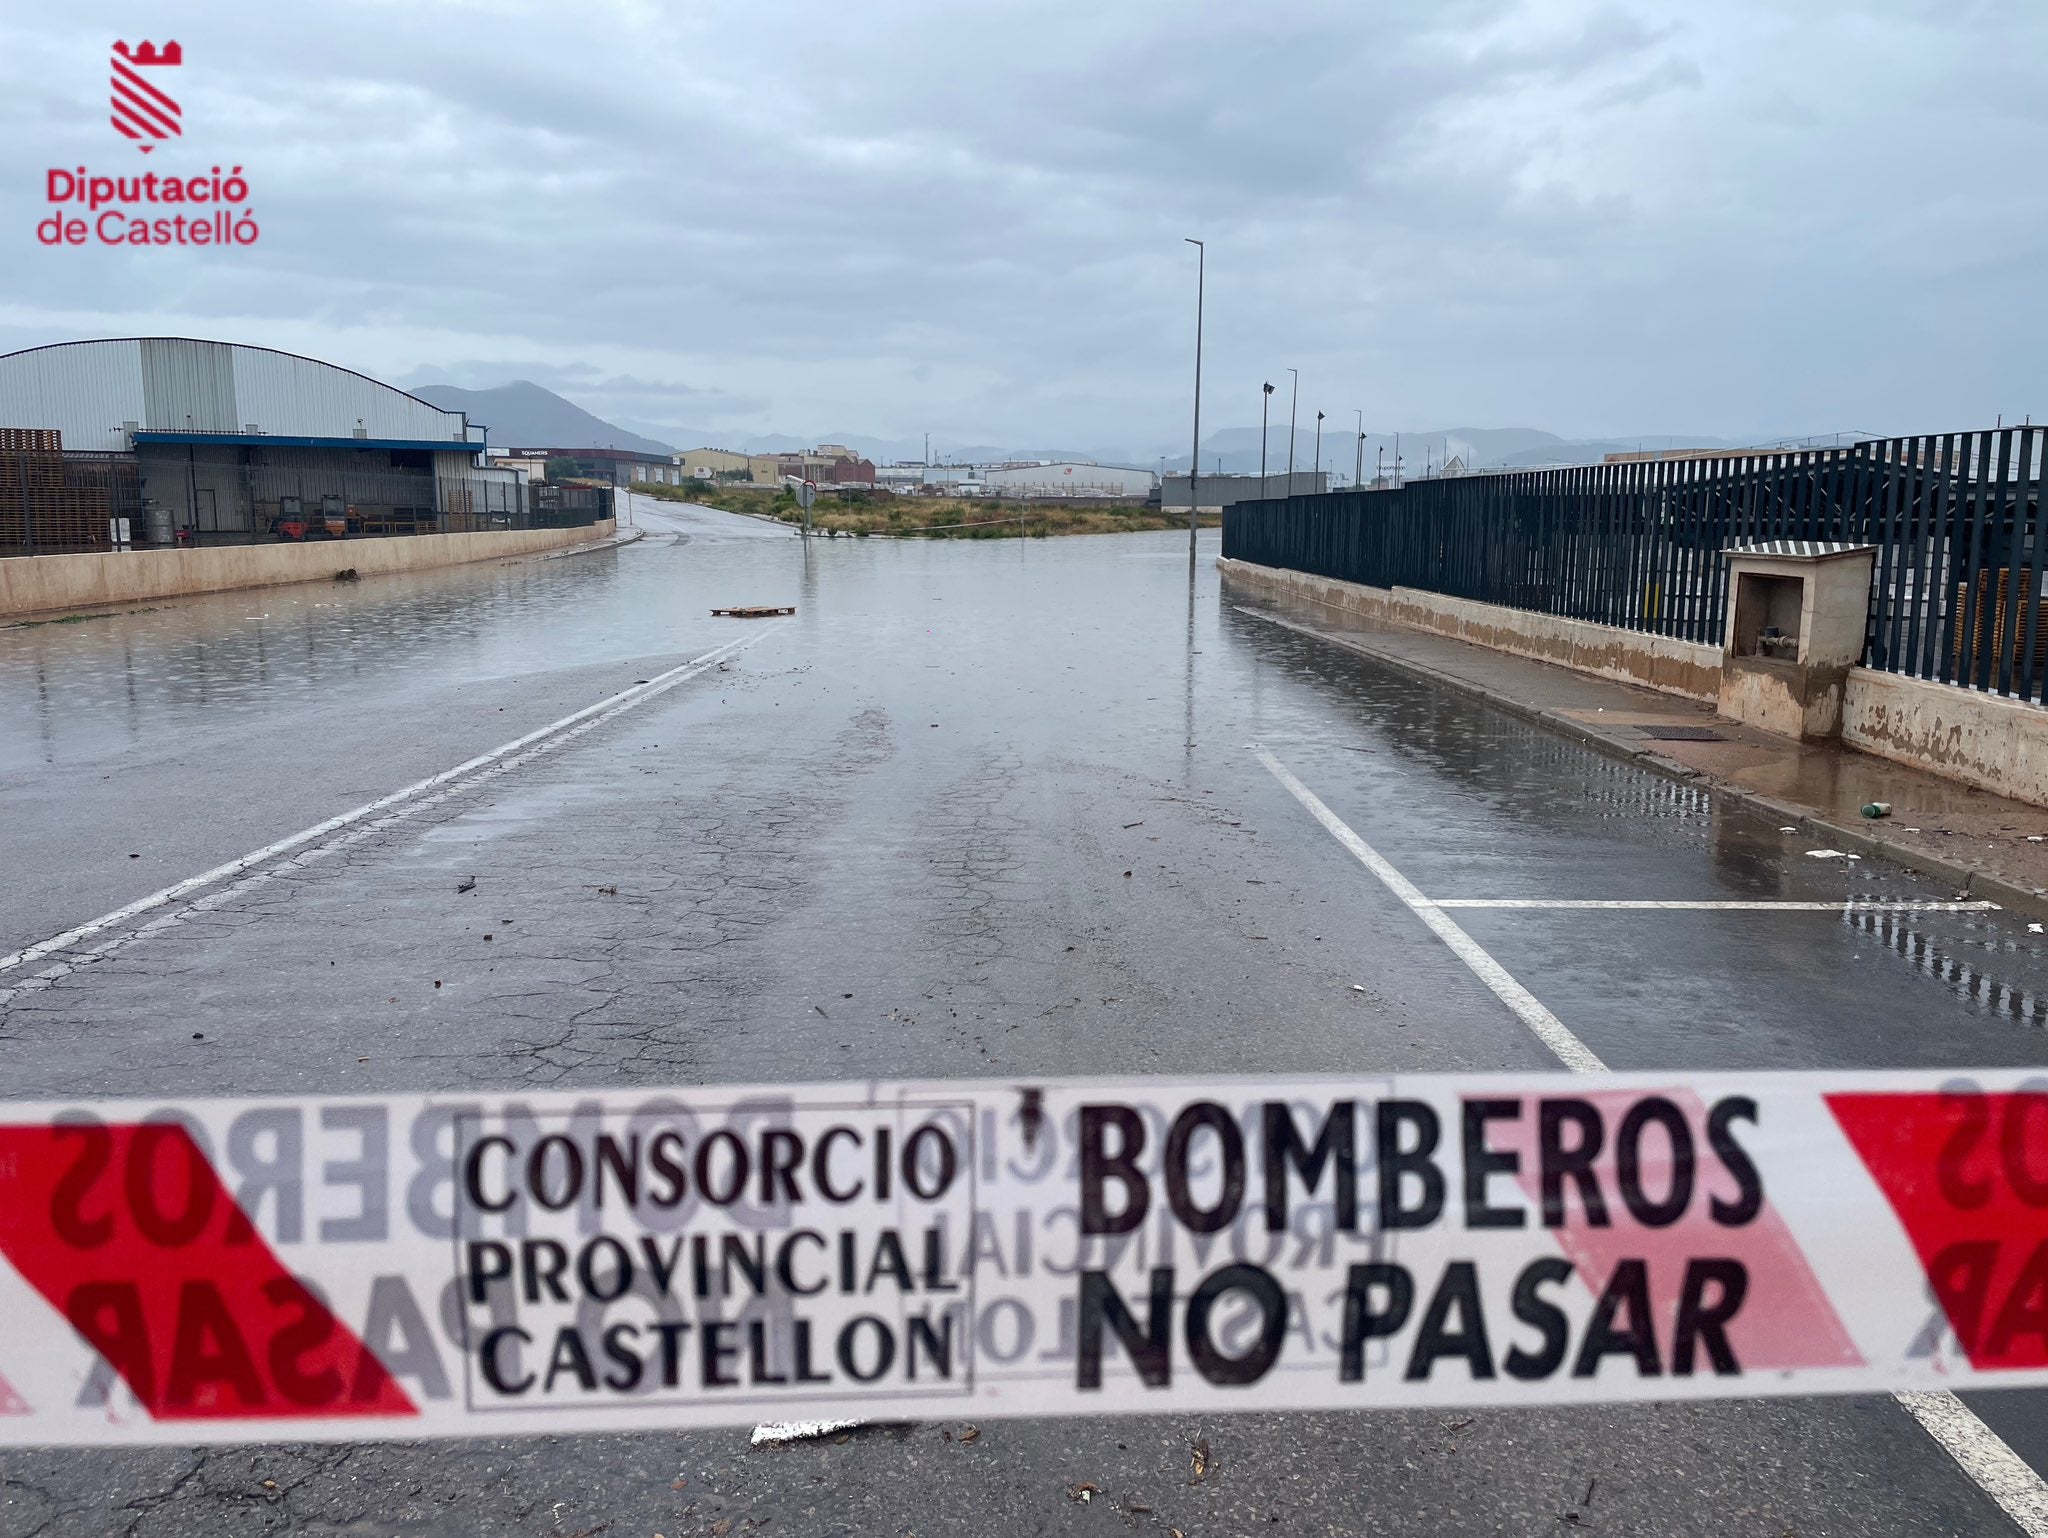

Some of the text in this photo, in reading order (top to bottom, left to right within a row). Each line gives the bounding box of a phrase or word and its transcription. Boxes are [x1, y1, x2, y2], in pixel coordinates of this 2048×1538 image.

[464, 1122, 959, 1213] CONSORCIO
[1079, 1095, 1764, 1237] BOMBEROS
[467, 1228, 960, 1302] PROVINCIAL
[479, 1314, 953, 1397] CASTELLON
[1076, 1256, 1749, 1392] NO PASAR
